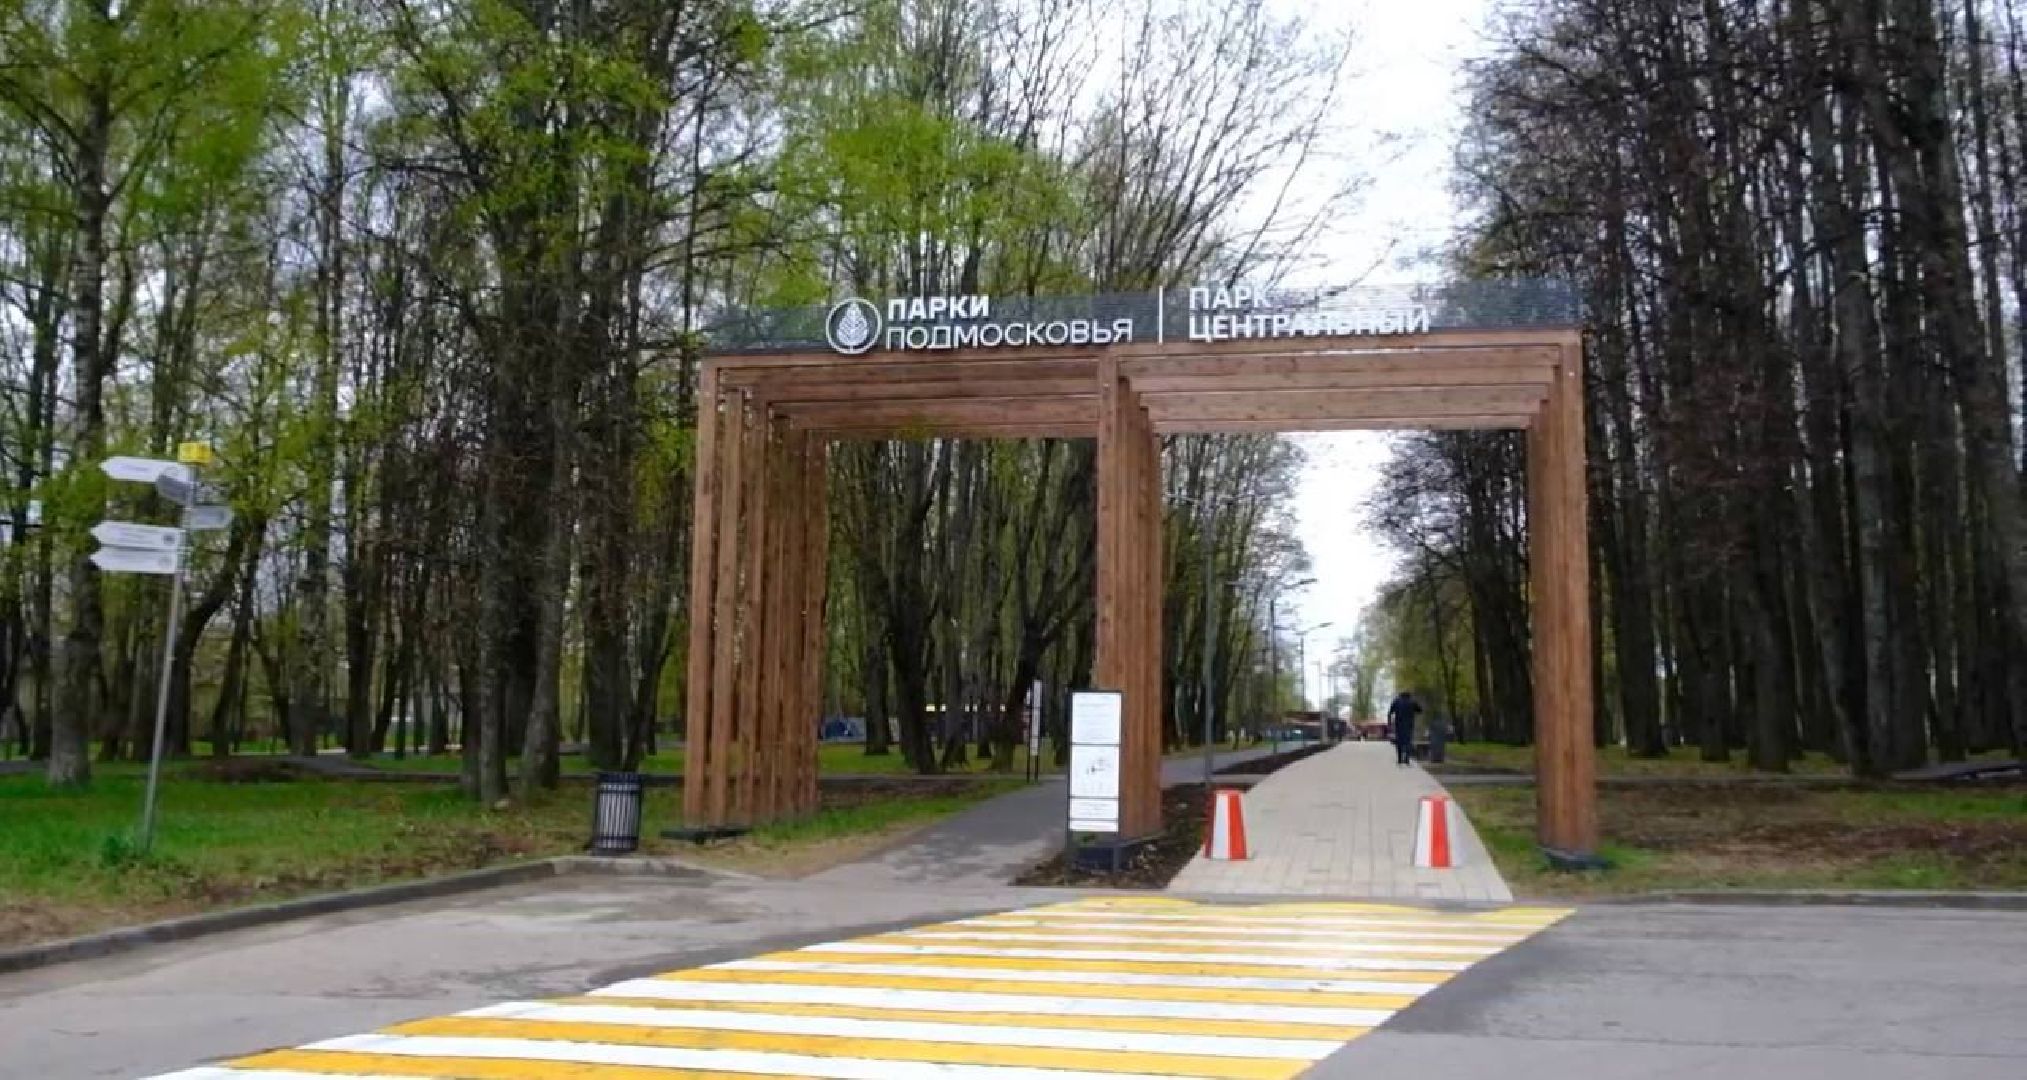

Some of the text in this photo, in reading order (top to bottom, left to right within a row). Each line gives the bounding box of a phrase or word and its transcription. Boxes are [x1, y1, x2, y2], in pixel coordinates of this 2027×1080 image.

[887, 295, 990, 320] ПАРКИ
[1189, 286, 1271, 309] ПАРК
[886, 318, 1133, 350] ПОДМОСКОВЬЯ
[1189, 304, 1431, 343] ЦЕНТРАЛЬНЫЙ
